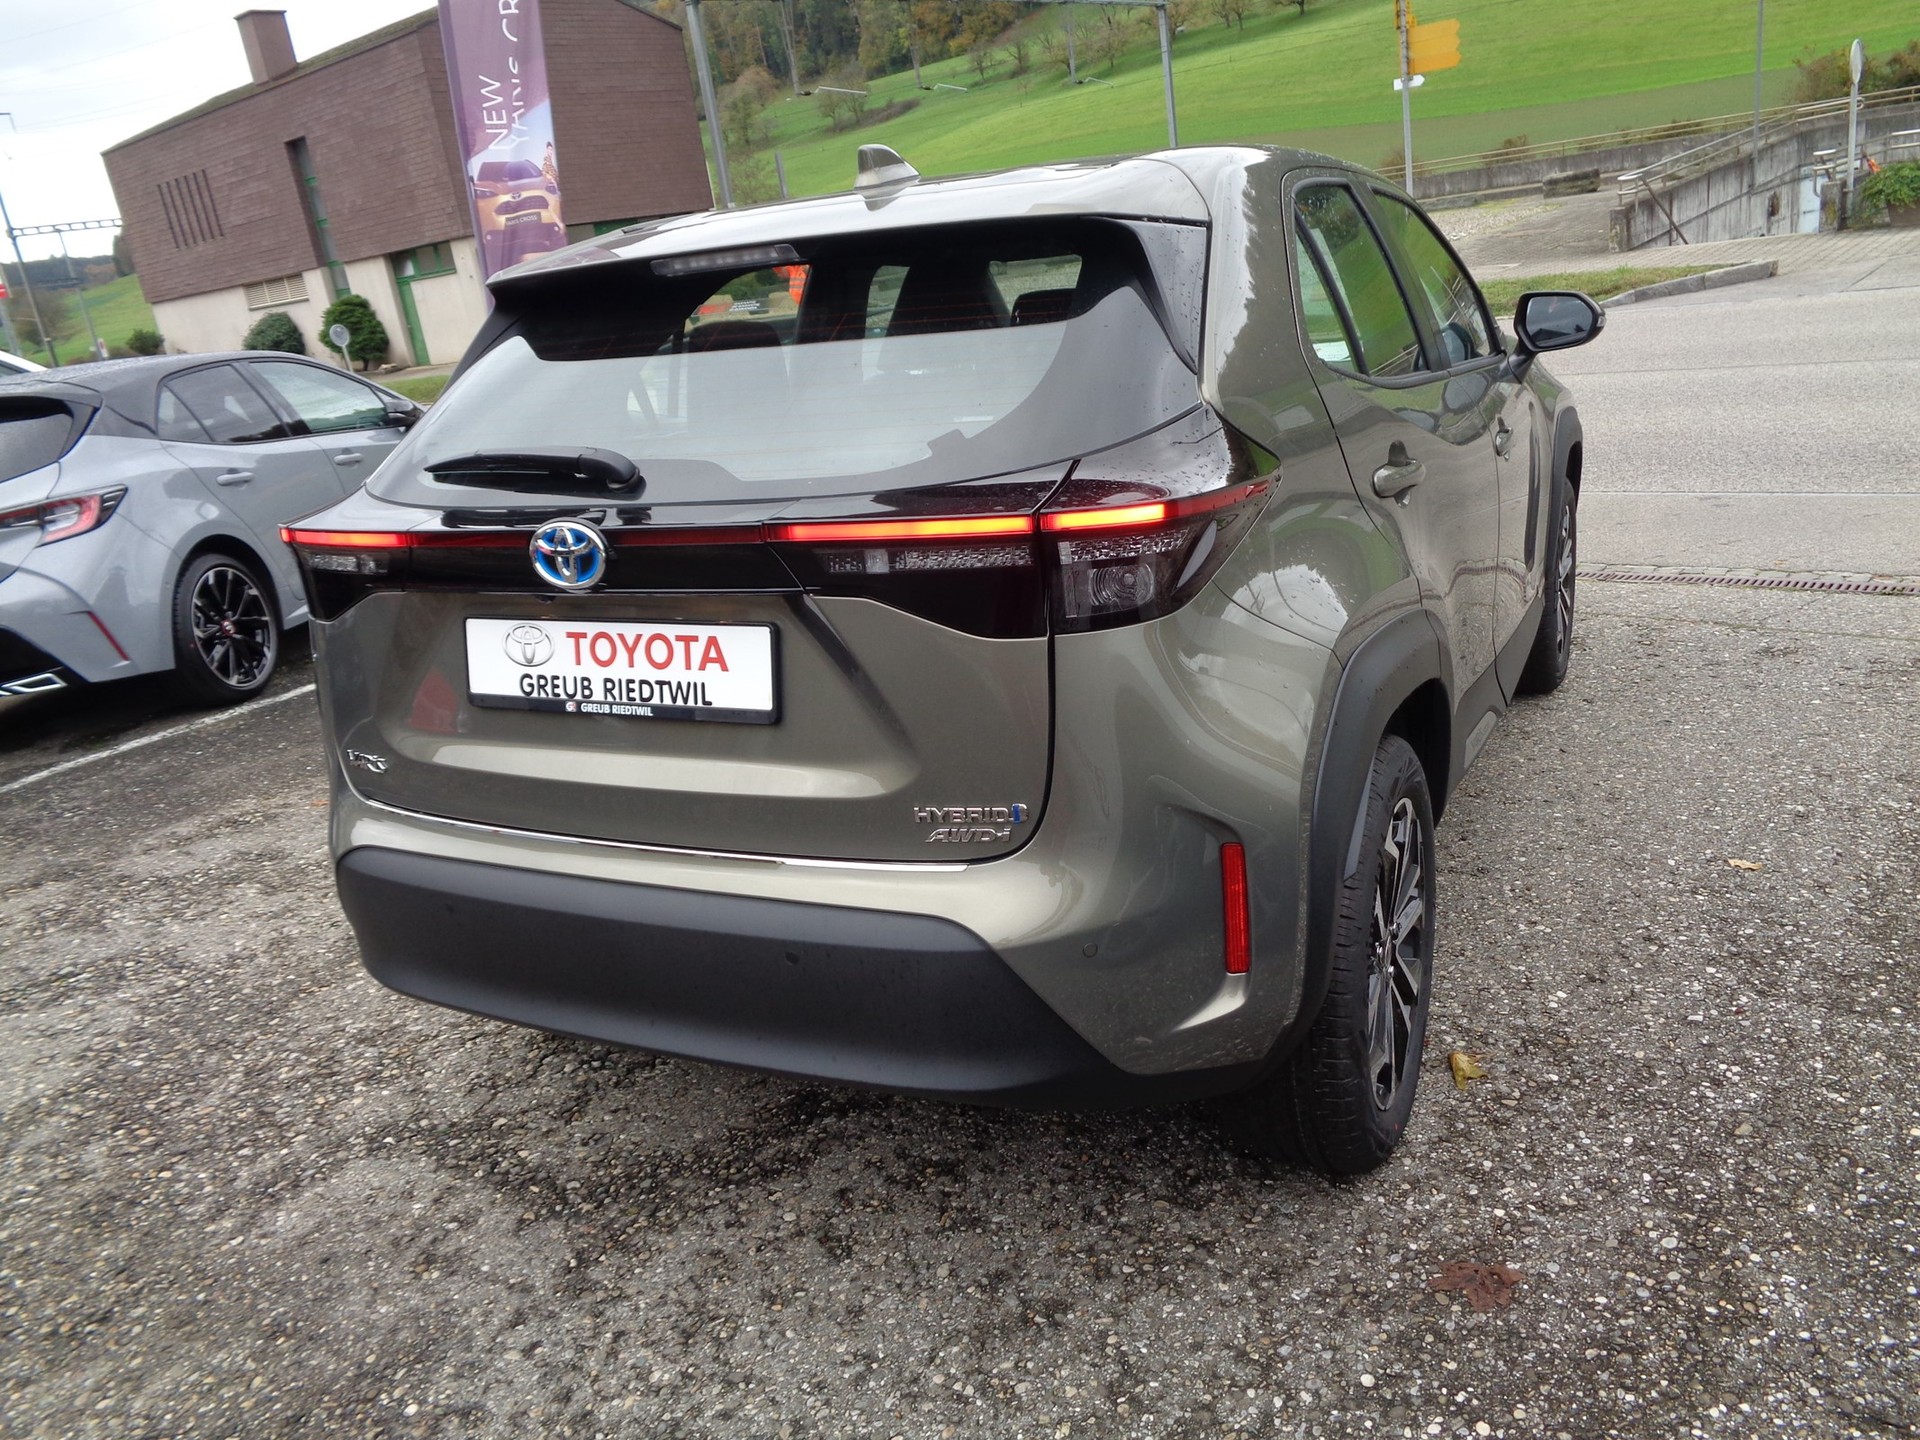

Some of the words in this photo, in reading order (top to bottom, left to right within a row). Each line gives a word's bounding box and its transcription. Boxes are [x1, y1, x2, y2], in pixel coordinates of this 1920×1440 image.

[478, 74, 512, 150] NEW
[519, 214, 538, 223] CROSS
[566, 631, 729, 672] TOYOTA
[519, 673, 594, 700] GREUB
[602, 676, 713, 706] RIEDTWIL
[581, 702, 610, 714] GREUB
[612, 705, 653, 717] RIEDTWIL
[913, 807, 1009, 823] HYBRID
